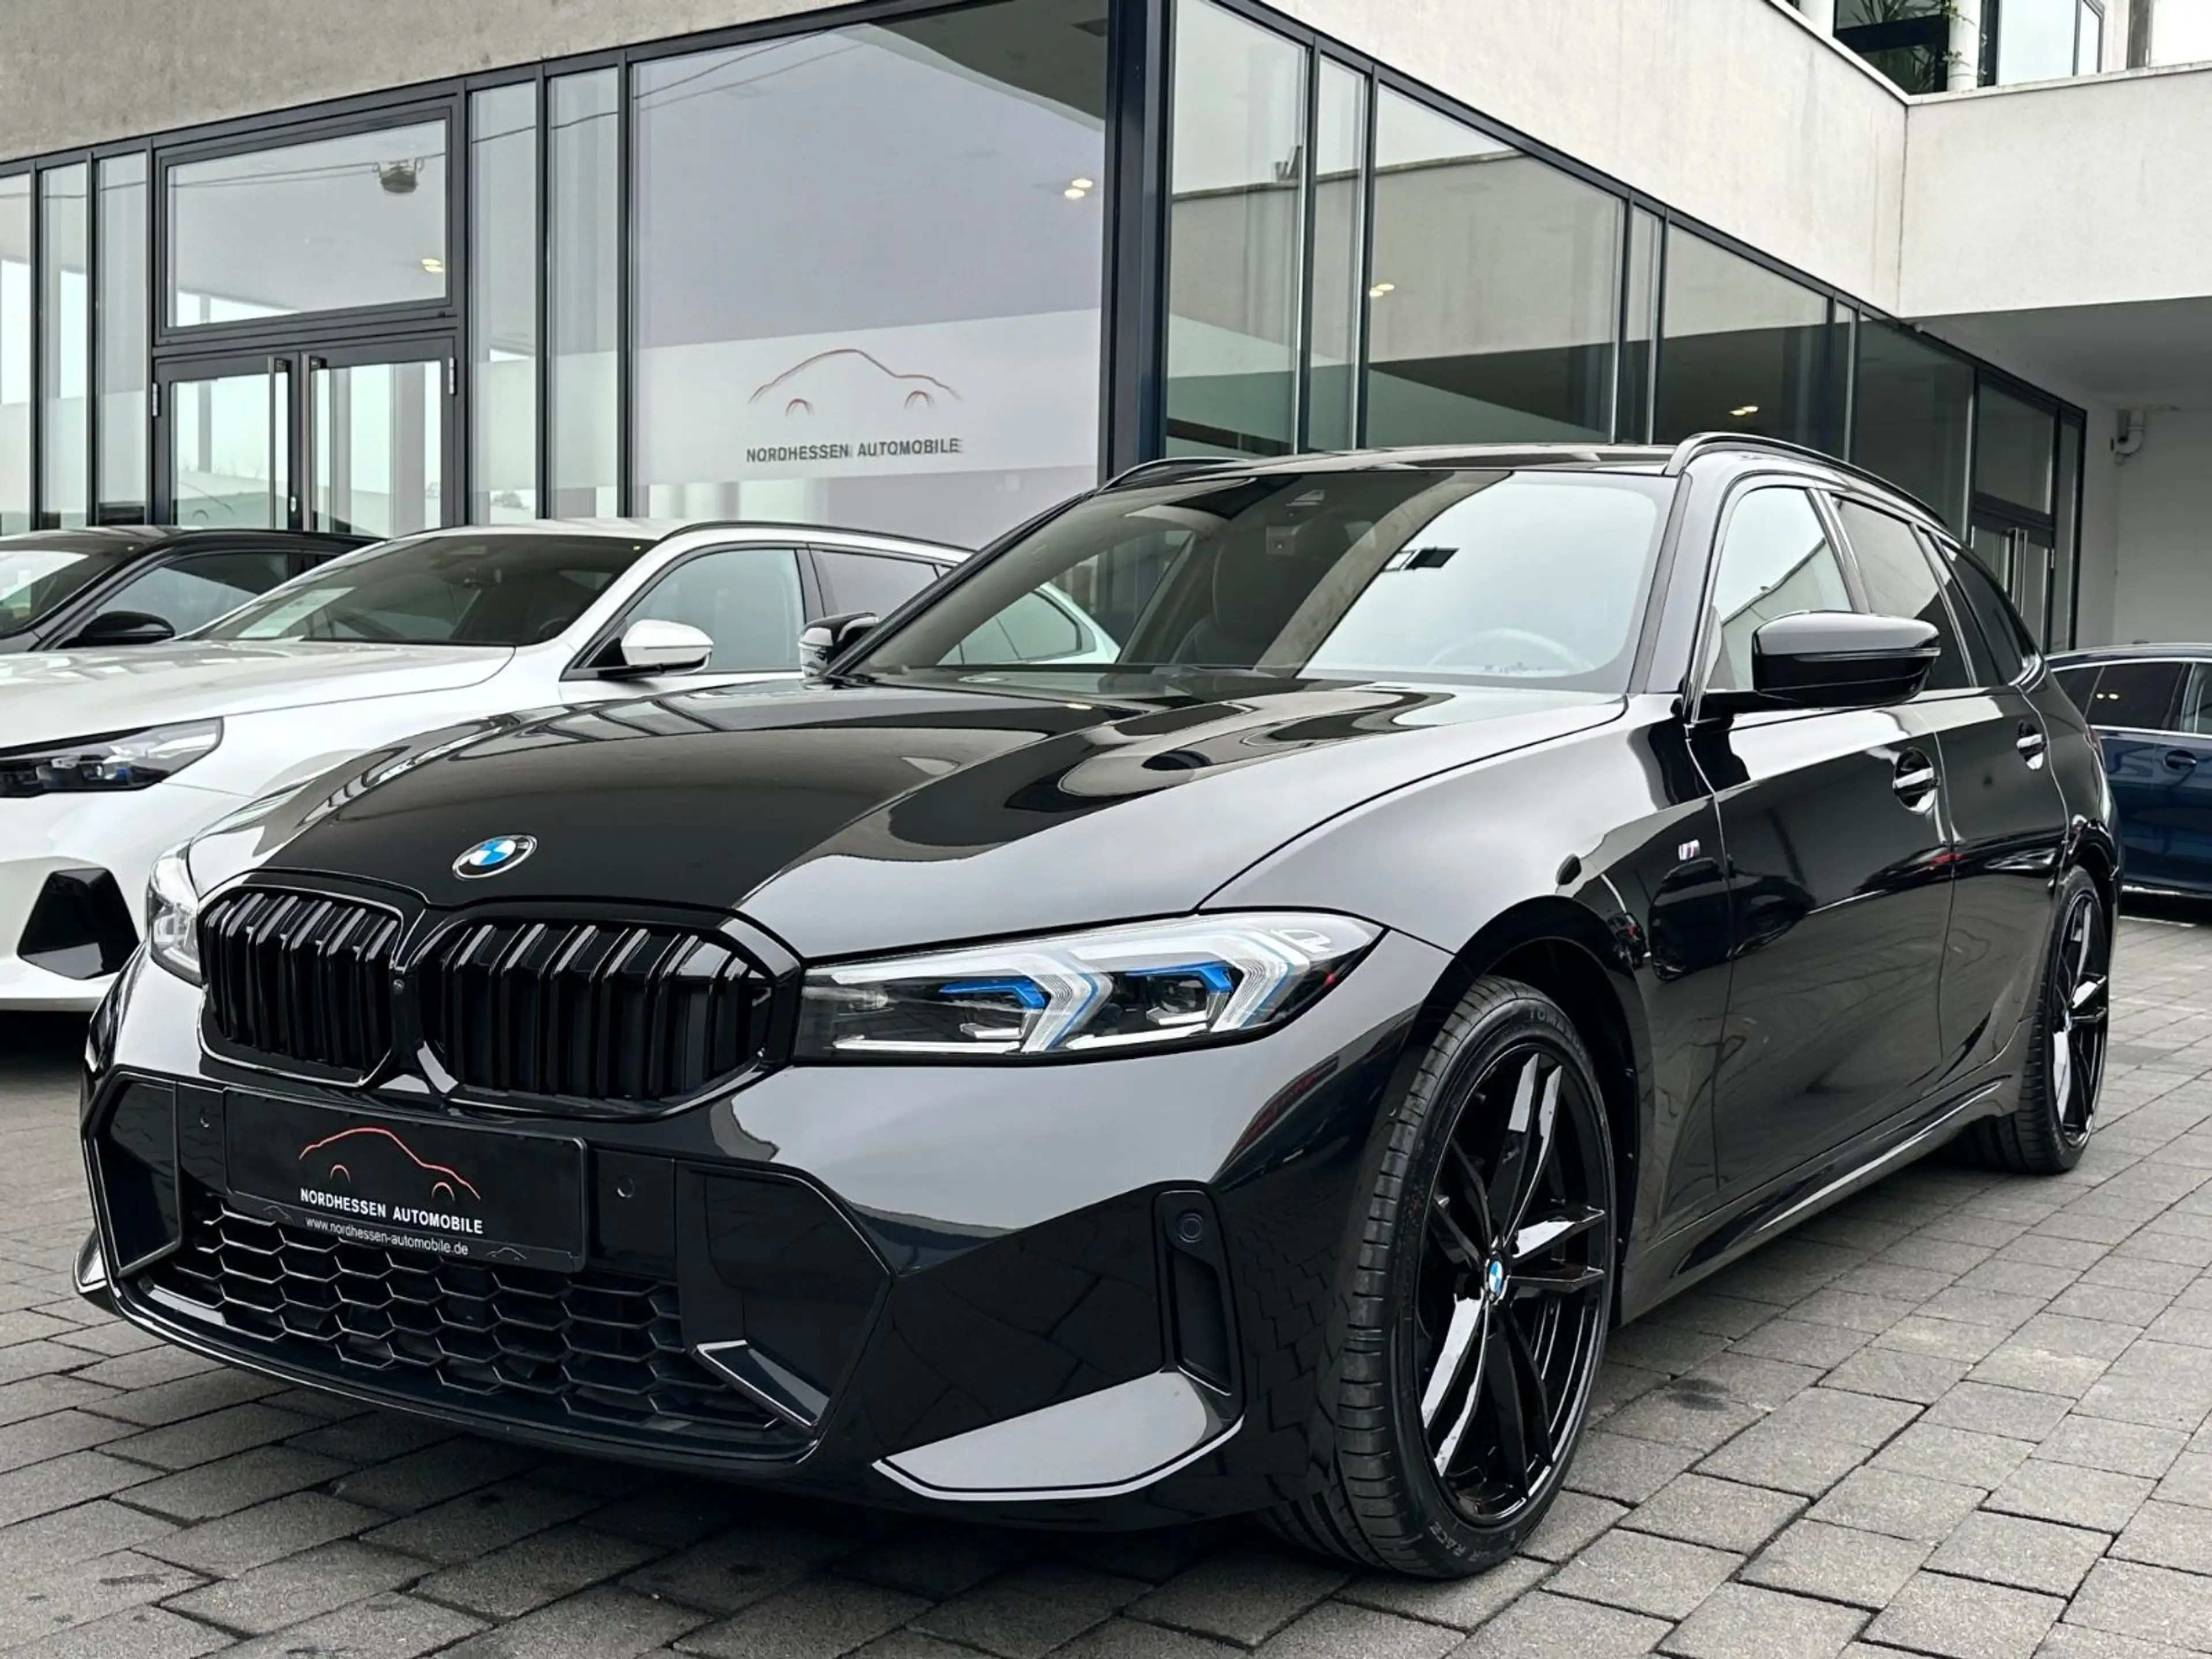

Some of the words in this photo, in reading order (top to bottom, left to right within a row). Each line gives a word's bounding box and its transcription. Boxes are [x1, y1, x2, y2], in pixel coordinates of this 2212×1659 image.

[746, 443, 850, 463] NORDHESSEN
[857, 437, 963, 457] AUTOMOBILE
[300, 1187, 387, 1218] NORDHESSEN
[392, 1206, 483, 1234] AUTOMOBILE
[305, 1217, 468, 1255] www.nordhessen-automobile.de
